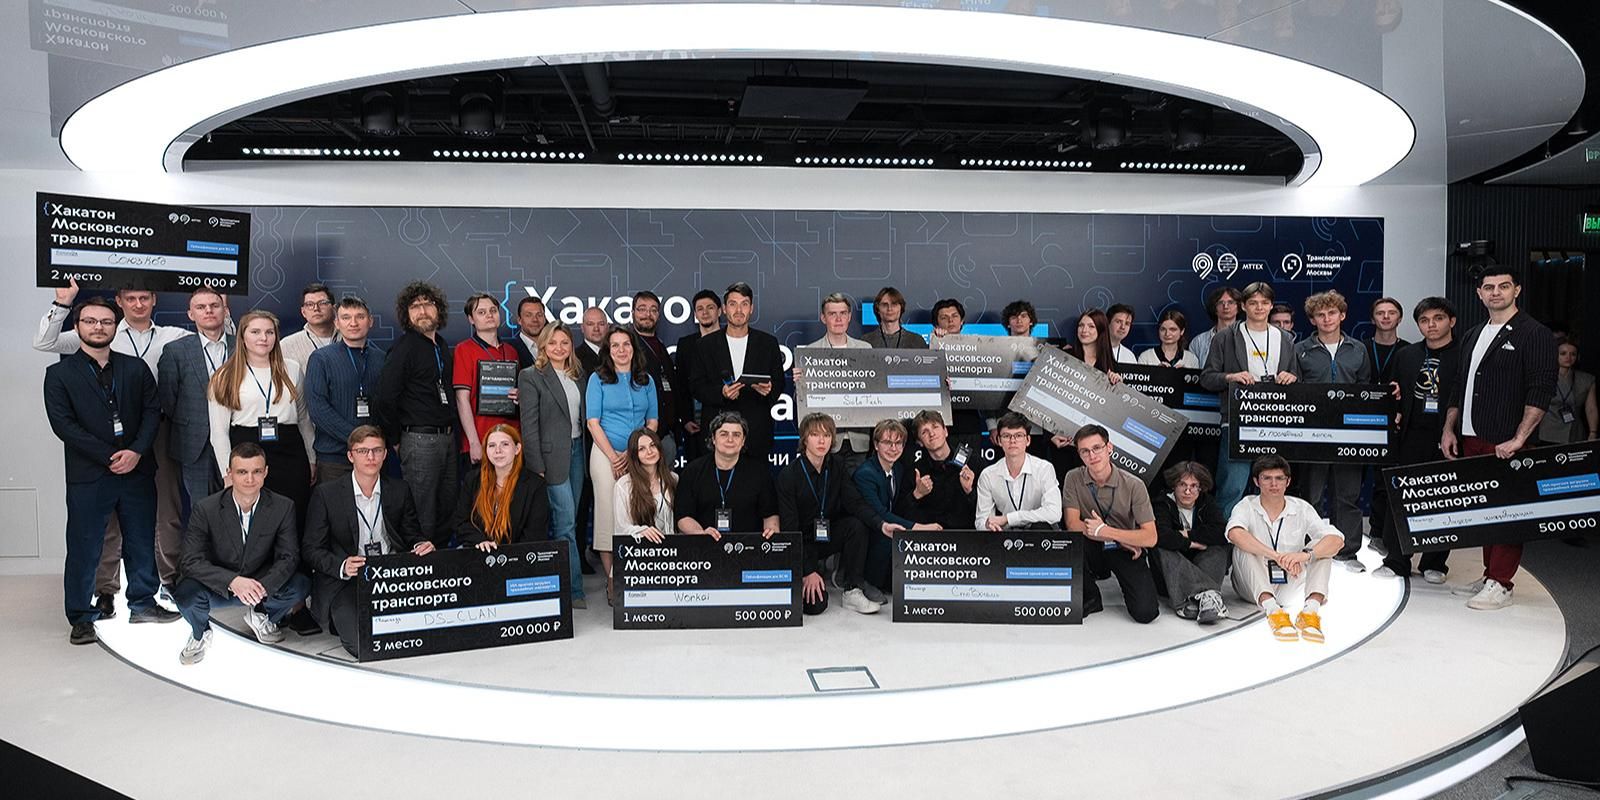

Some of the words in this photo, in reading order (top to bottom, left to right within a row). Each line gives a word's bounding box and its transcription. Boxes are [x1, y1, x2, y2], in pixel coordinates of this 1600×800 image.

[51, 203, 116, 220] Хакатон
[51, 218, 154, 236] Московского
[51, 234, 139, 249] транспорта
[1306, 254, 1351, 263] Транспортные
[1306, 263, 1341, 272] инновации
[51, 270, 60, 280] 2
[63, 272, 103, 281] место
[1306, 270, 1333, 278] Москвы
[178, 276, 201, 287] 300
[204, 277, 227, 288] 000
[939, 342, 977, 352] Хакатон
[804, 356, 848, 366] Хакатон
[805, 368, 876, 378] Московского
[1046, 355, 1087, 382] Хакатон
[805, 381, 866, 391] транспорта
[1040, 365, 1106, 405] Московского
[1036, 376, 1091, 410] транспорта
[1239, 389, 1287, 400] Хакатон
[1020, 400, 1027, 409] 2
[1026, 406, 1052, 423] место
[1239, 401, 1317, 412] Московского
[1239, 414, 1305, 425] транспорта
[1188, 426, 1203, 435] 200
[1205, 427, 1221, 436] 000
[1239, 444, 1245, 453] 3
[1247, 446, 1277, 454] место
[1337, 447, 1357, 456] 200
[1359, 448, 1379, 457] 000
[1119, 456, 1138, 471] 000
[1398, 472, 1458, 487] Хакатон
[1402, 480, 1499, 500] Московского
[1403, 495, 1487, 513] транспорта
[1539, 521, 1566, 532] 500
[1568, 518, 1597, 530] 000
[904, 540, 957, 552] Хакатон
[1411, 537, 1419, 546] 1
[1421, 534, 1458, 545] место
[624, 546, 678, 557] Хакатон
[624, 560, 712, 571] Московского
[904, 554, 991, 565] Московского
[371, 565, 433, 580] Хакатон
[904, 569, 978, 581] транспорта
[371, 577, 472, 594] Московского
[624, 575, 698, 587] транспорта
[371, 593, 458, 612] транспорта
[735, 610, 757, 621] 500
[759, 610, 782, 620] 000
[904, 605, 909, 615] 1
[912, 607, 945, 615] место
[1014, 606, 1036, 616] 500
[1038, 606, 1061, 616] 000
[624, 613, 630, 622] 1
[632, 614, 666, 622] место
[500, 625, 524, 637] 200
[526, 622, 550, 634] 000
[373, 641, 381, 652] 3
[384, 638, 423, 651] место
